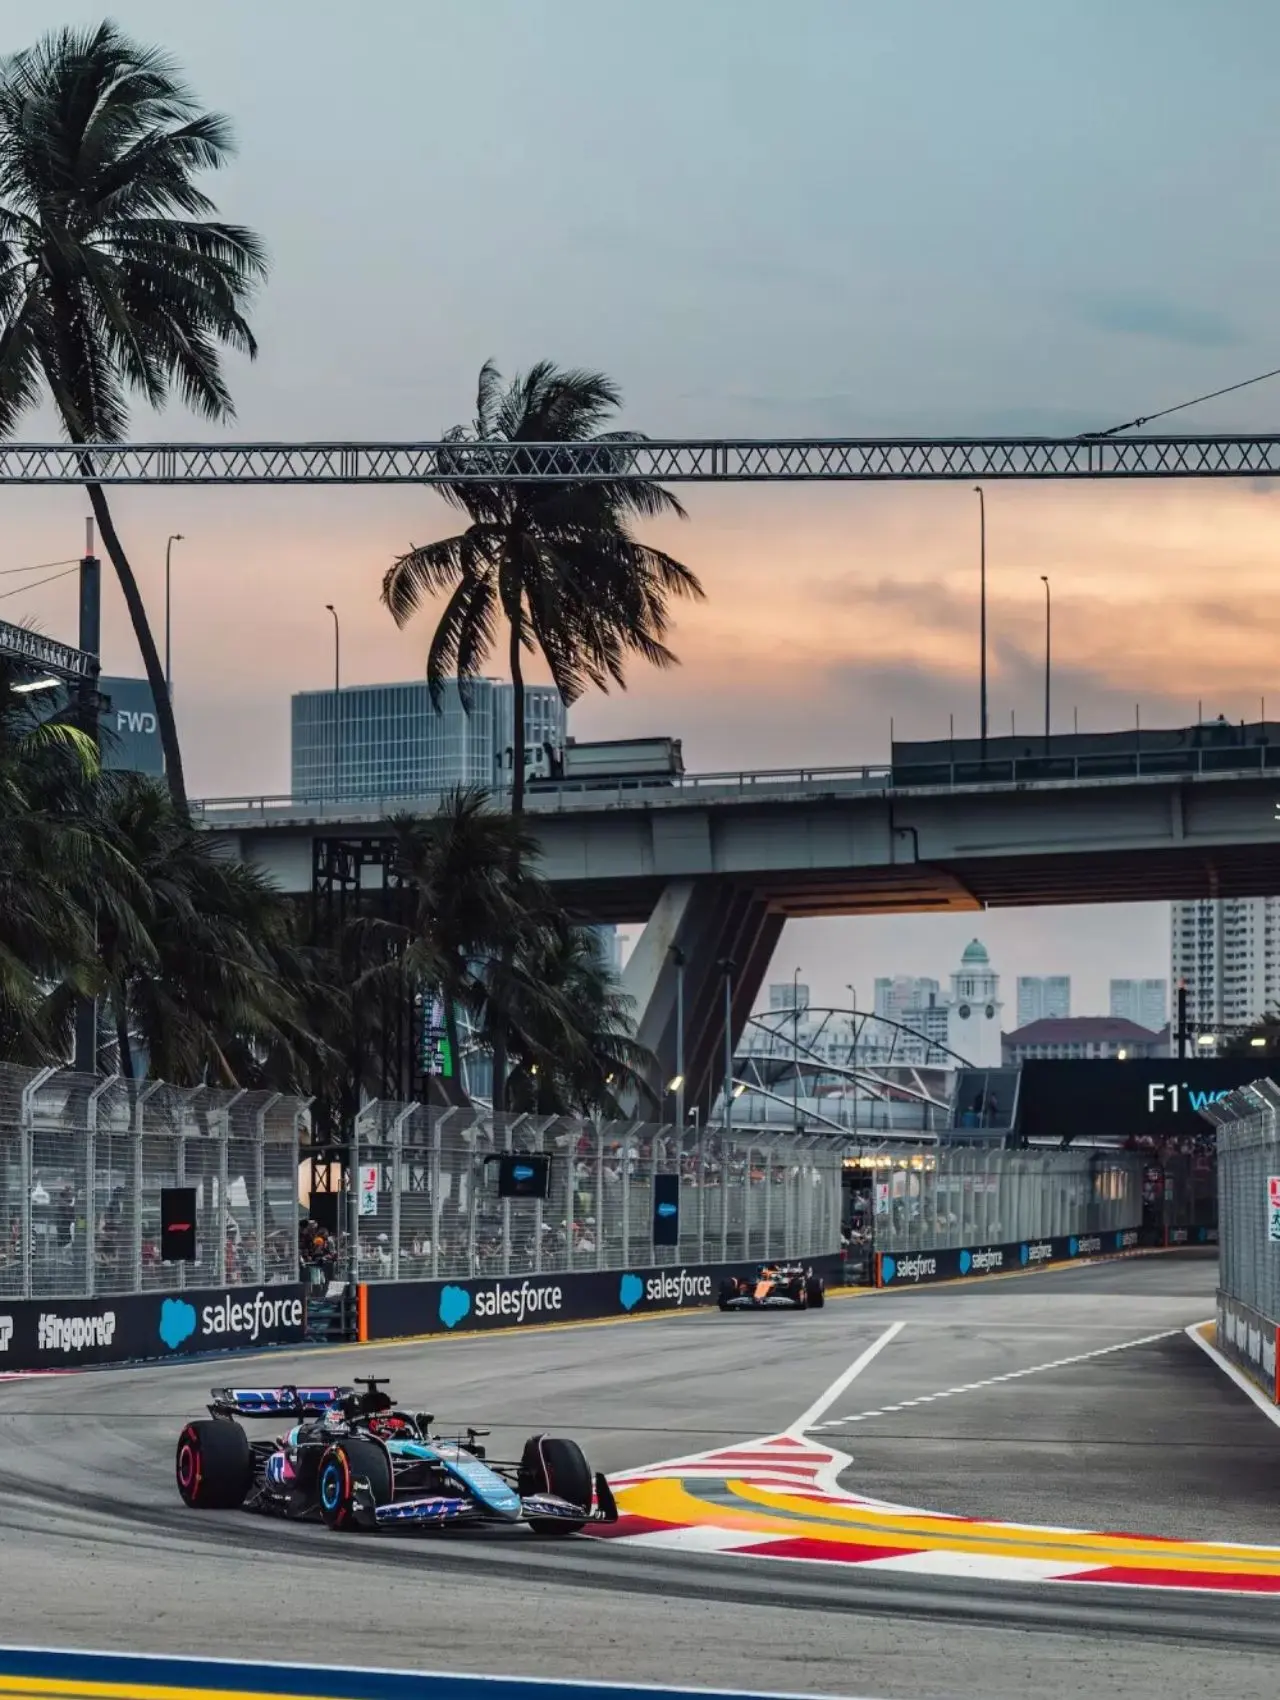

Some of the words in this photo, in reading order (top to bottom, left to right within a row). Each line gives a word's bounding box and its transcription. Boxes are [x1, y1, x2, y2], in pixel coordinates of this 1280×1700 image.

[117, 710, 157, 734] FWD
[1148, 1083, 1179, 1112] F1
[896, 1254, 936, 1282] salesforce
[972, 1248, 1003, 1273] salesforce
[475, 1281, 562, 1322] salesforce
[646, 1269, 712, 1305] salesforce
[38, 1311, 116, 1352] #SingaporeGP
[202, 1291, 303, 1340] salesforce
